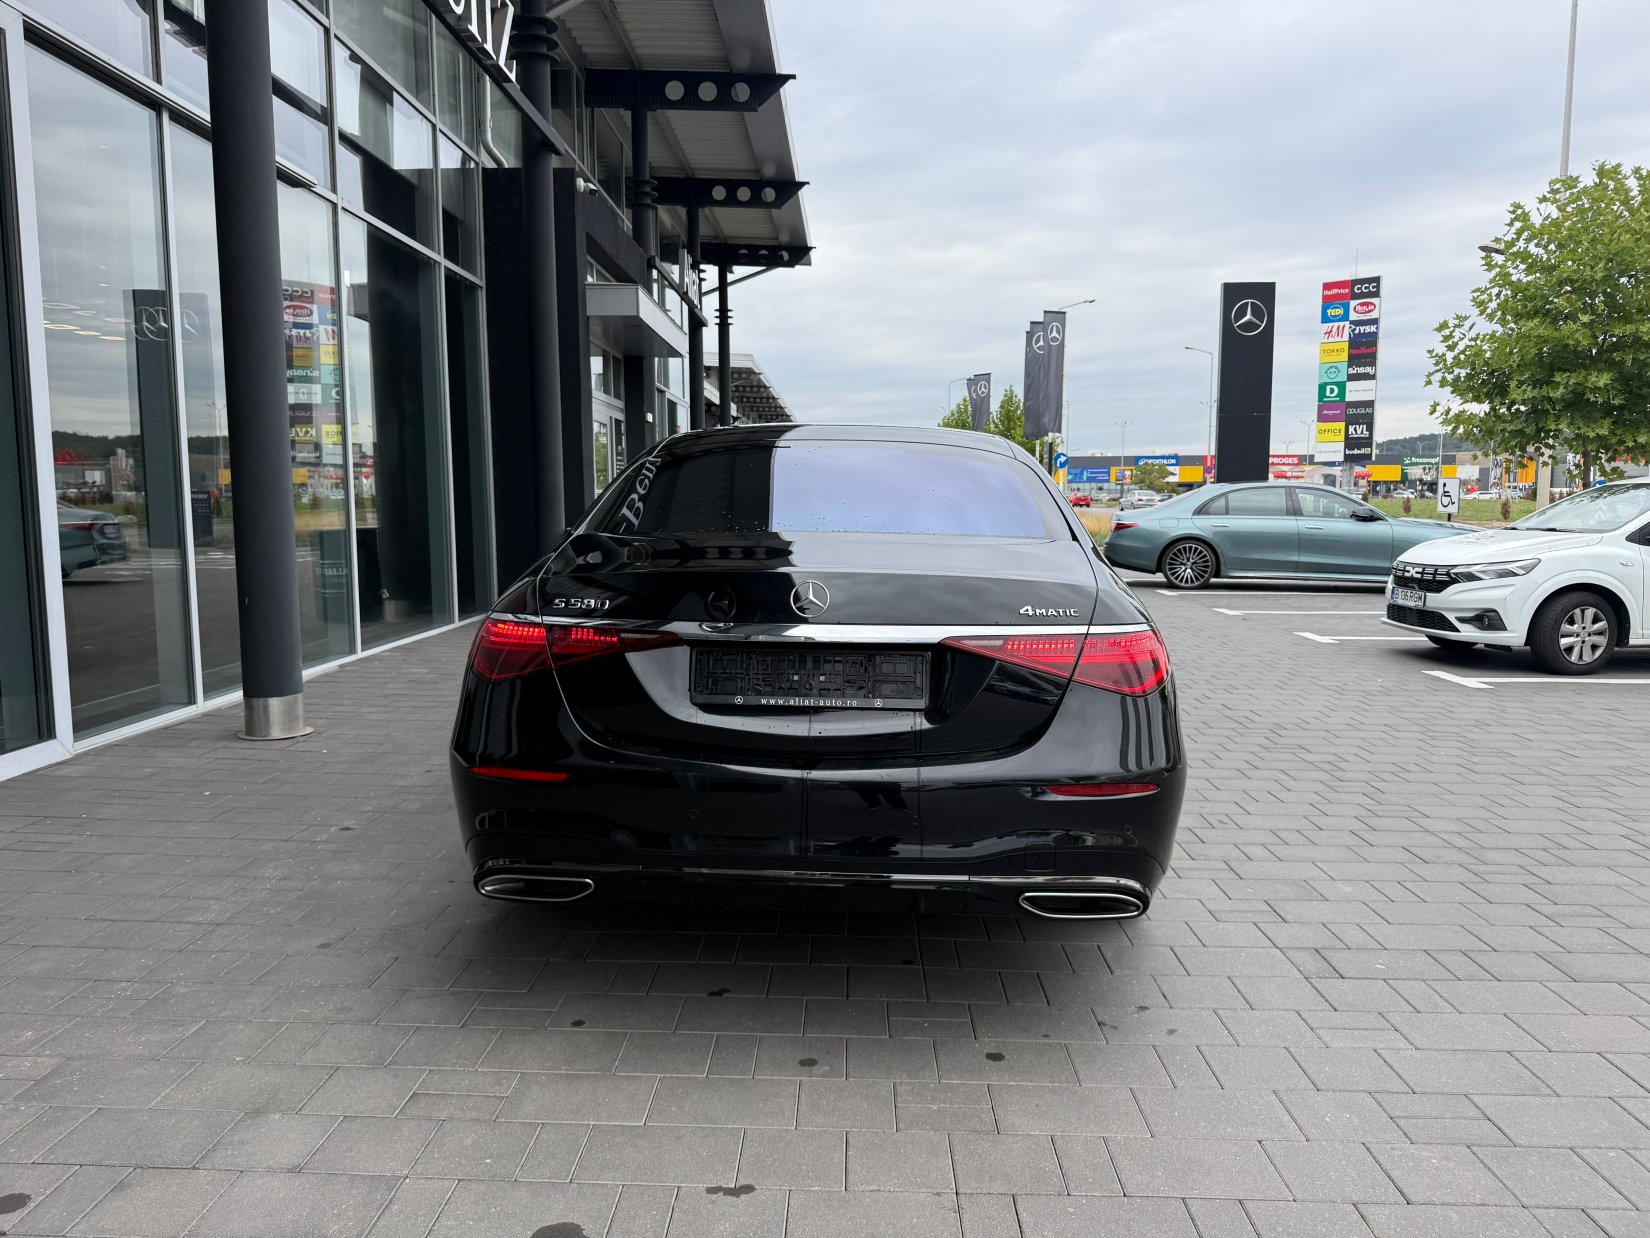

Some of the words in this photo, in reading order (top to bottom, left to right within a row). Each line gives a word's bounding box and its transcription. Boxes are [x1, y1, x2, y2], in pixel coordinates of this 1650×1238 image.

[1354, 283, 1377, 293] CCC
[1323, 324, 1346, 340] H&M
[1354, 324, 1377, 334] JYSK
[1348, 365, 1375, 375] sinsay
[1325, 385, 1339, 397] D
[1348, 424, 1369, 435] KVL
[552, 598, 566, 609] S
[567, 598, 610, 610] 580
[1019, 605, 1080, 617] 4MATIC
[761, 697, 857, 707] www.aliat-auto.ro
